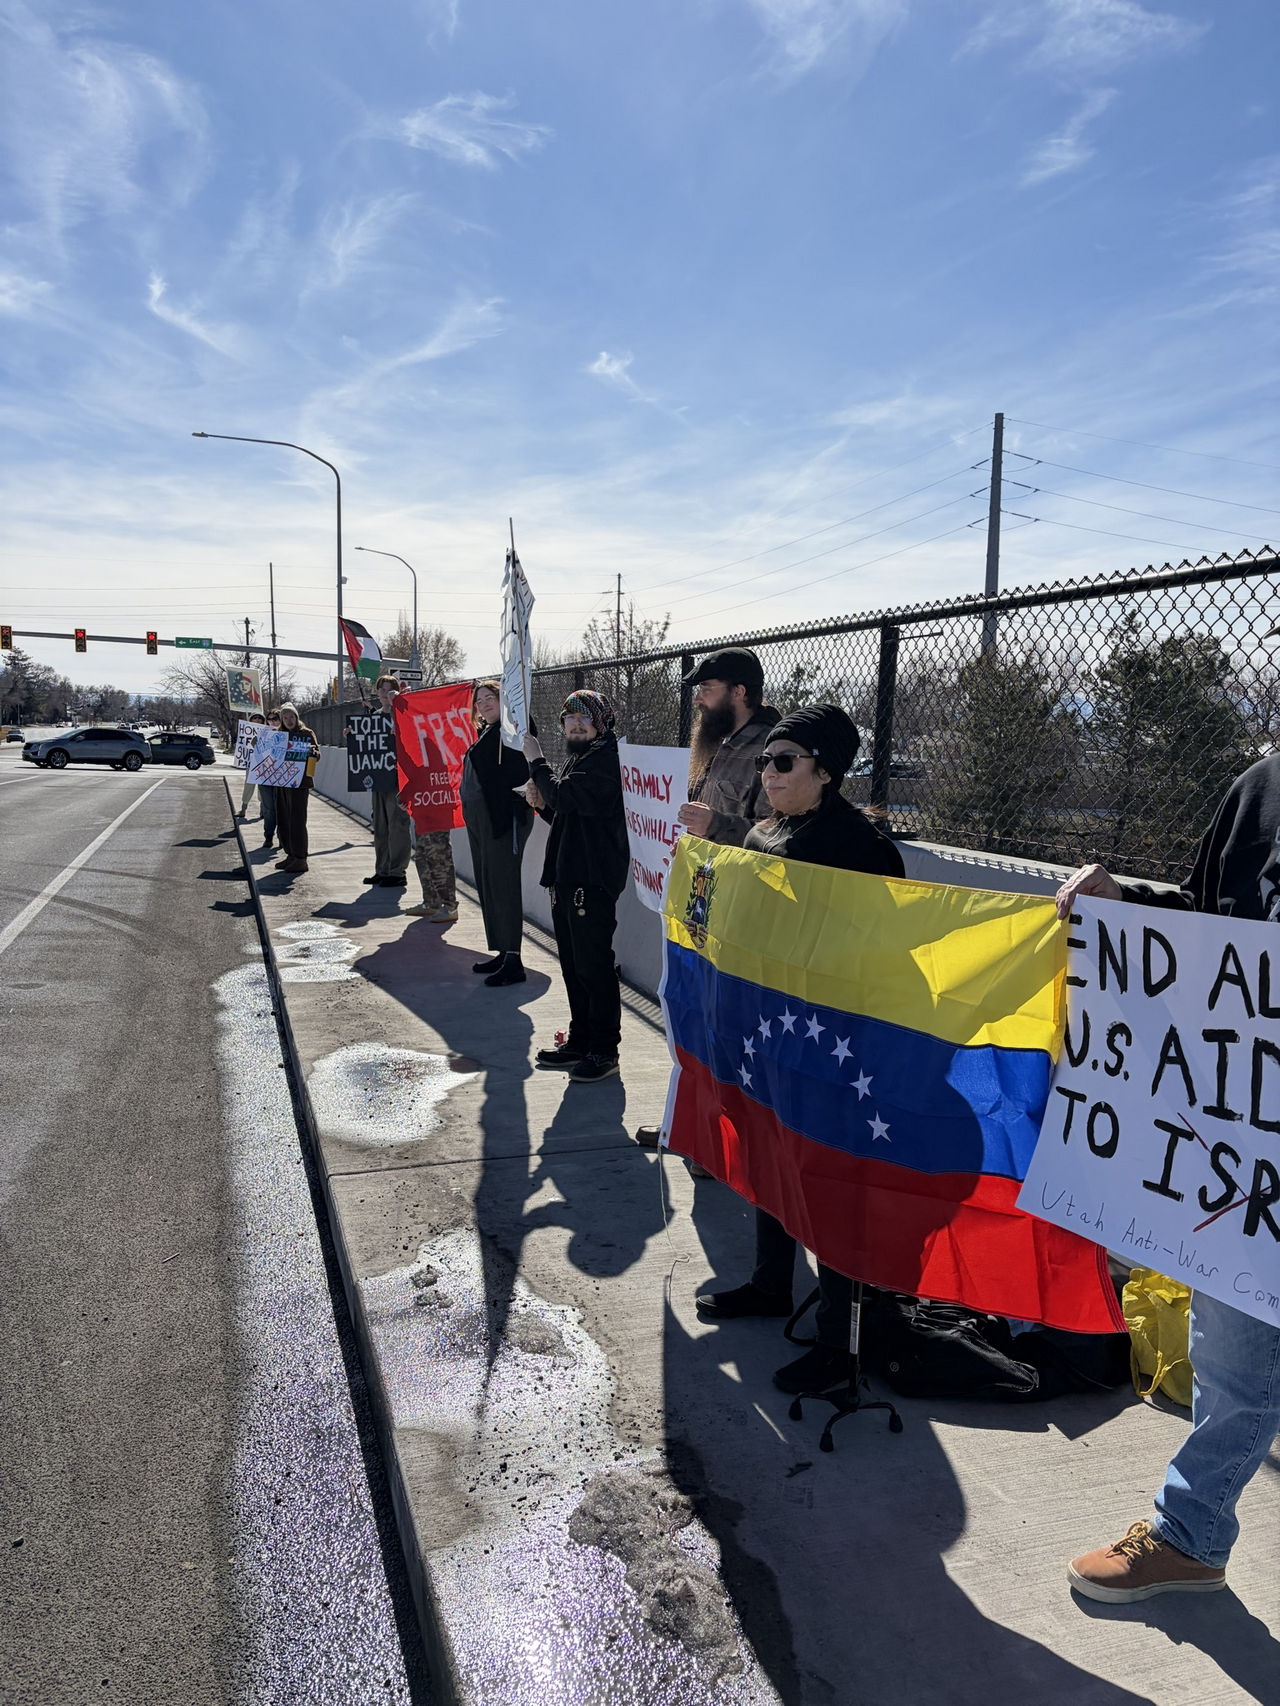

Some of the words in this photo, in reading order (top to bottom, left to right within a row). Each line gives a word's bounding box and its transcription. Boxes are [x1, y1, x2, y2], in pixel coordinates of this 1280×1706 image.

[238, 736, 252, 746] IF
[239, 723, 260, 736] HON
[350, 715, 394, 735] JOIN
[355, 734, 388, 752] THE
[349, 751, 396, 774] UAWC
[631, 766, 673, 804] FAMILY
[641, 813, 682, 846] WHILE
[1067, 913, 1177, 998] END
[1064, 1004, 1132, 1081] U.S.
[1151, 1023, 1280, 1133] AID
[1055, 1086, 1119, 1159] TO
[1143, 1119, 1280, 1243] ISR
[1042, 1182, 1104, 1231] Utah
[1121, 1217, 1219, 1278] Anti-War
